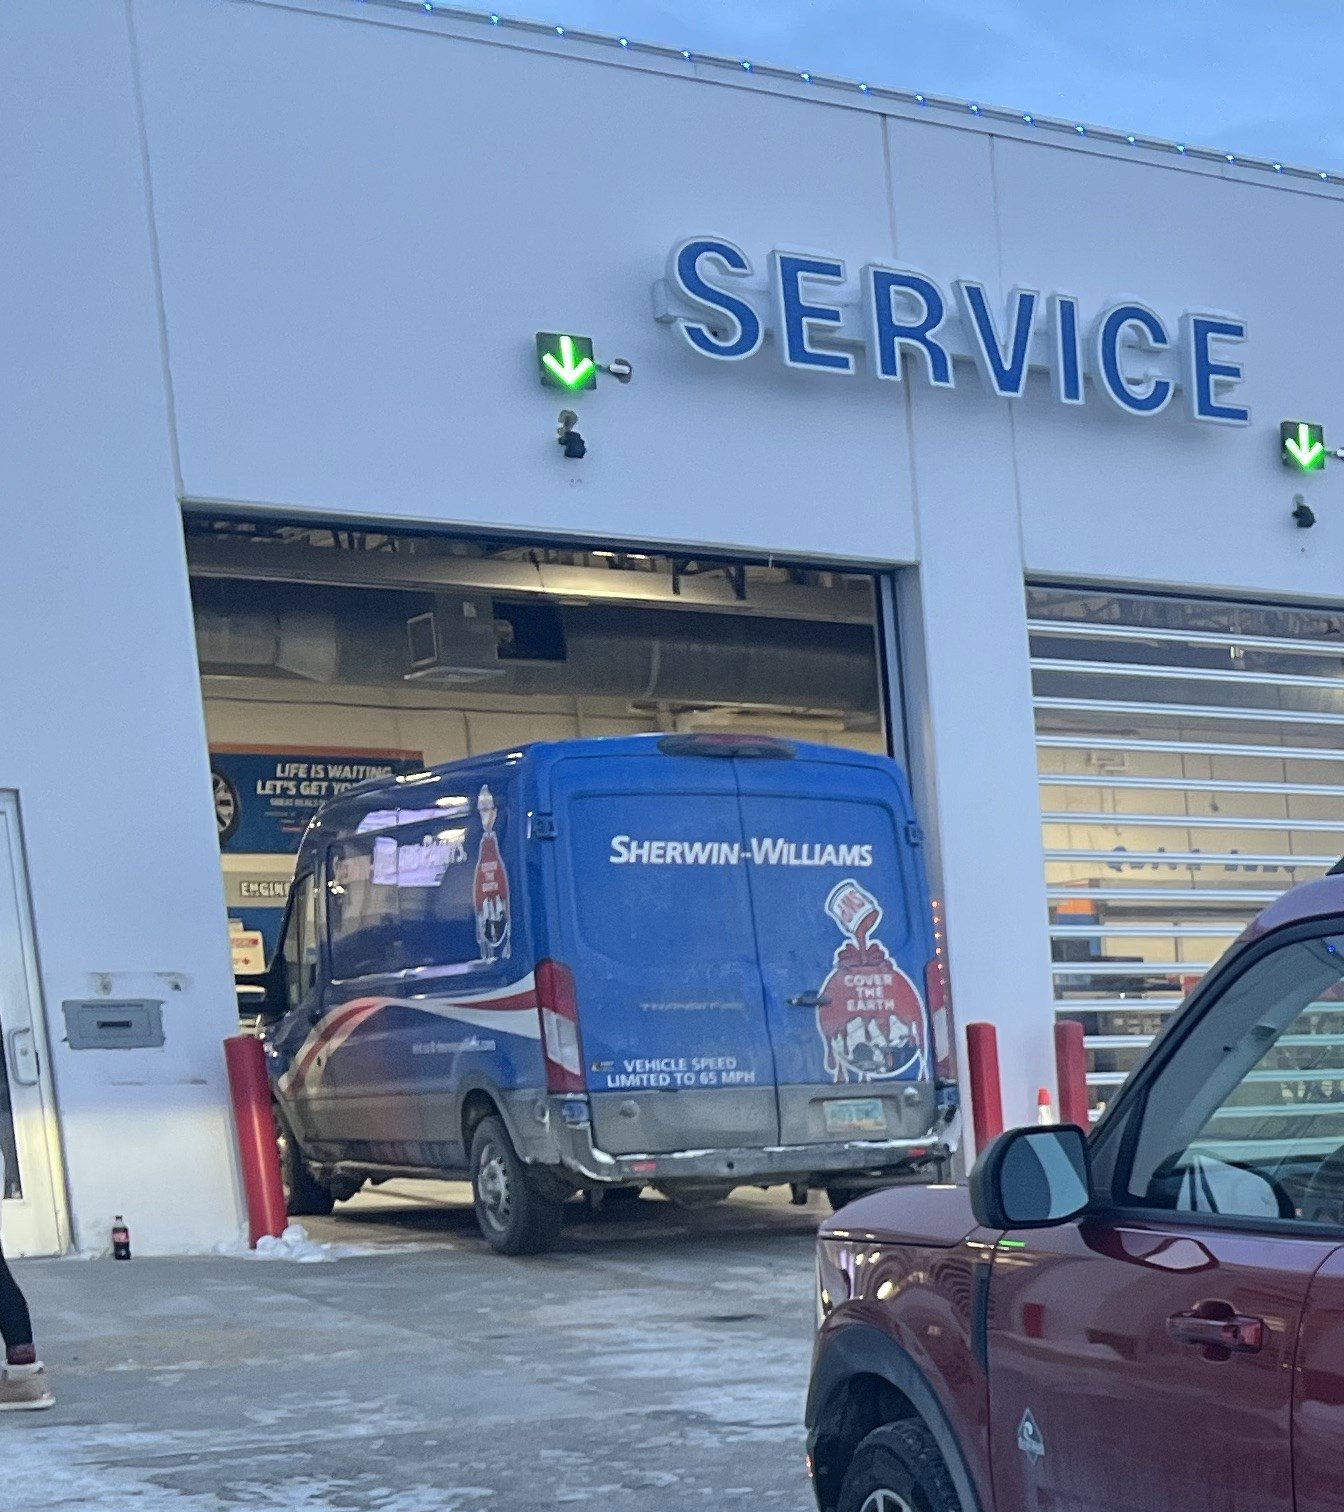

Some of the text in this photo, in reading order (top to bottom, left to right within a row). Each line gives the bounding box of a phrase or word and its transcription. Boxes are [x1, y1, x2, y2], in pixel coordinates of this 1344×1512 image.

[667, 233, 1252, 427] SERVICE
[275, 762, 309, 778] LIFE
[310, 764, 326, 778] IS
[256, 779, 296, 795] LET'S
[299, 780, 328, 796] GET
[608, 834, 873, 867] SHERWIN-WILLIAMS
[844, 973, 893, 986] COVER
[855, 986, 884, 998] THE
[846, 999, 895, 1011] EARTH
[623, 1057, 688, 1072] VEHICLE
[691, 1056, 737, 1071] SPEED
[607, 1070, 756, 1088] LIMITED TO 65 MPH
